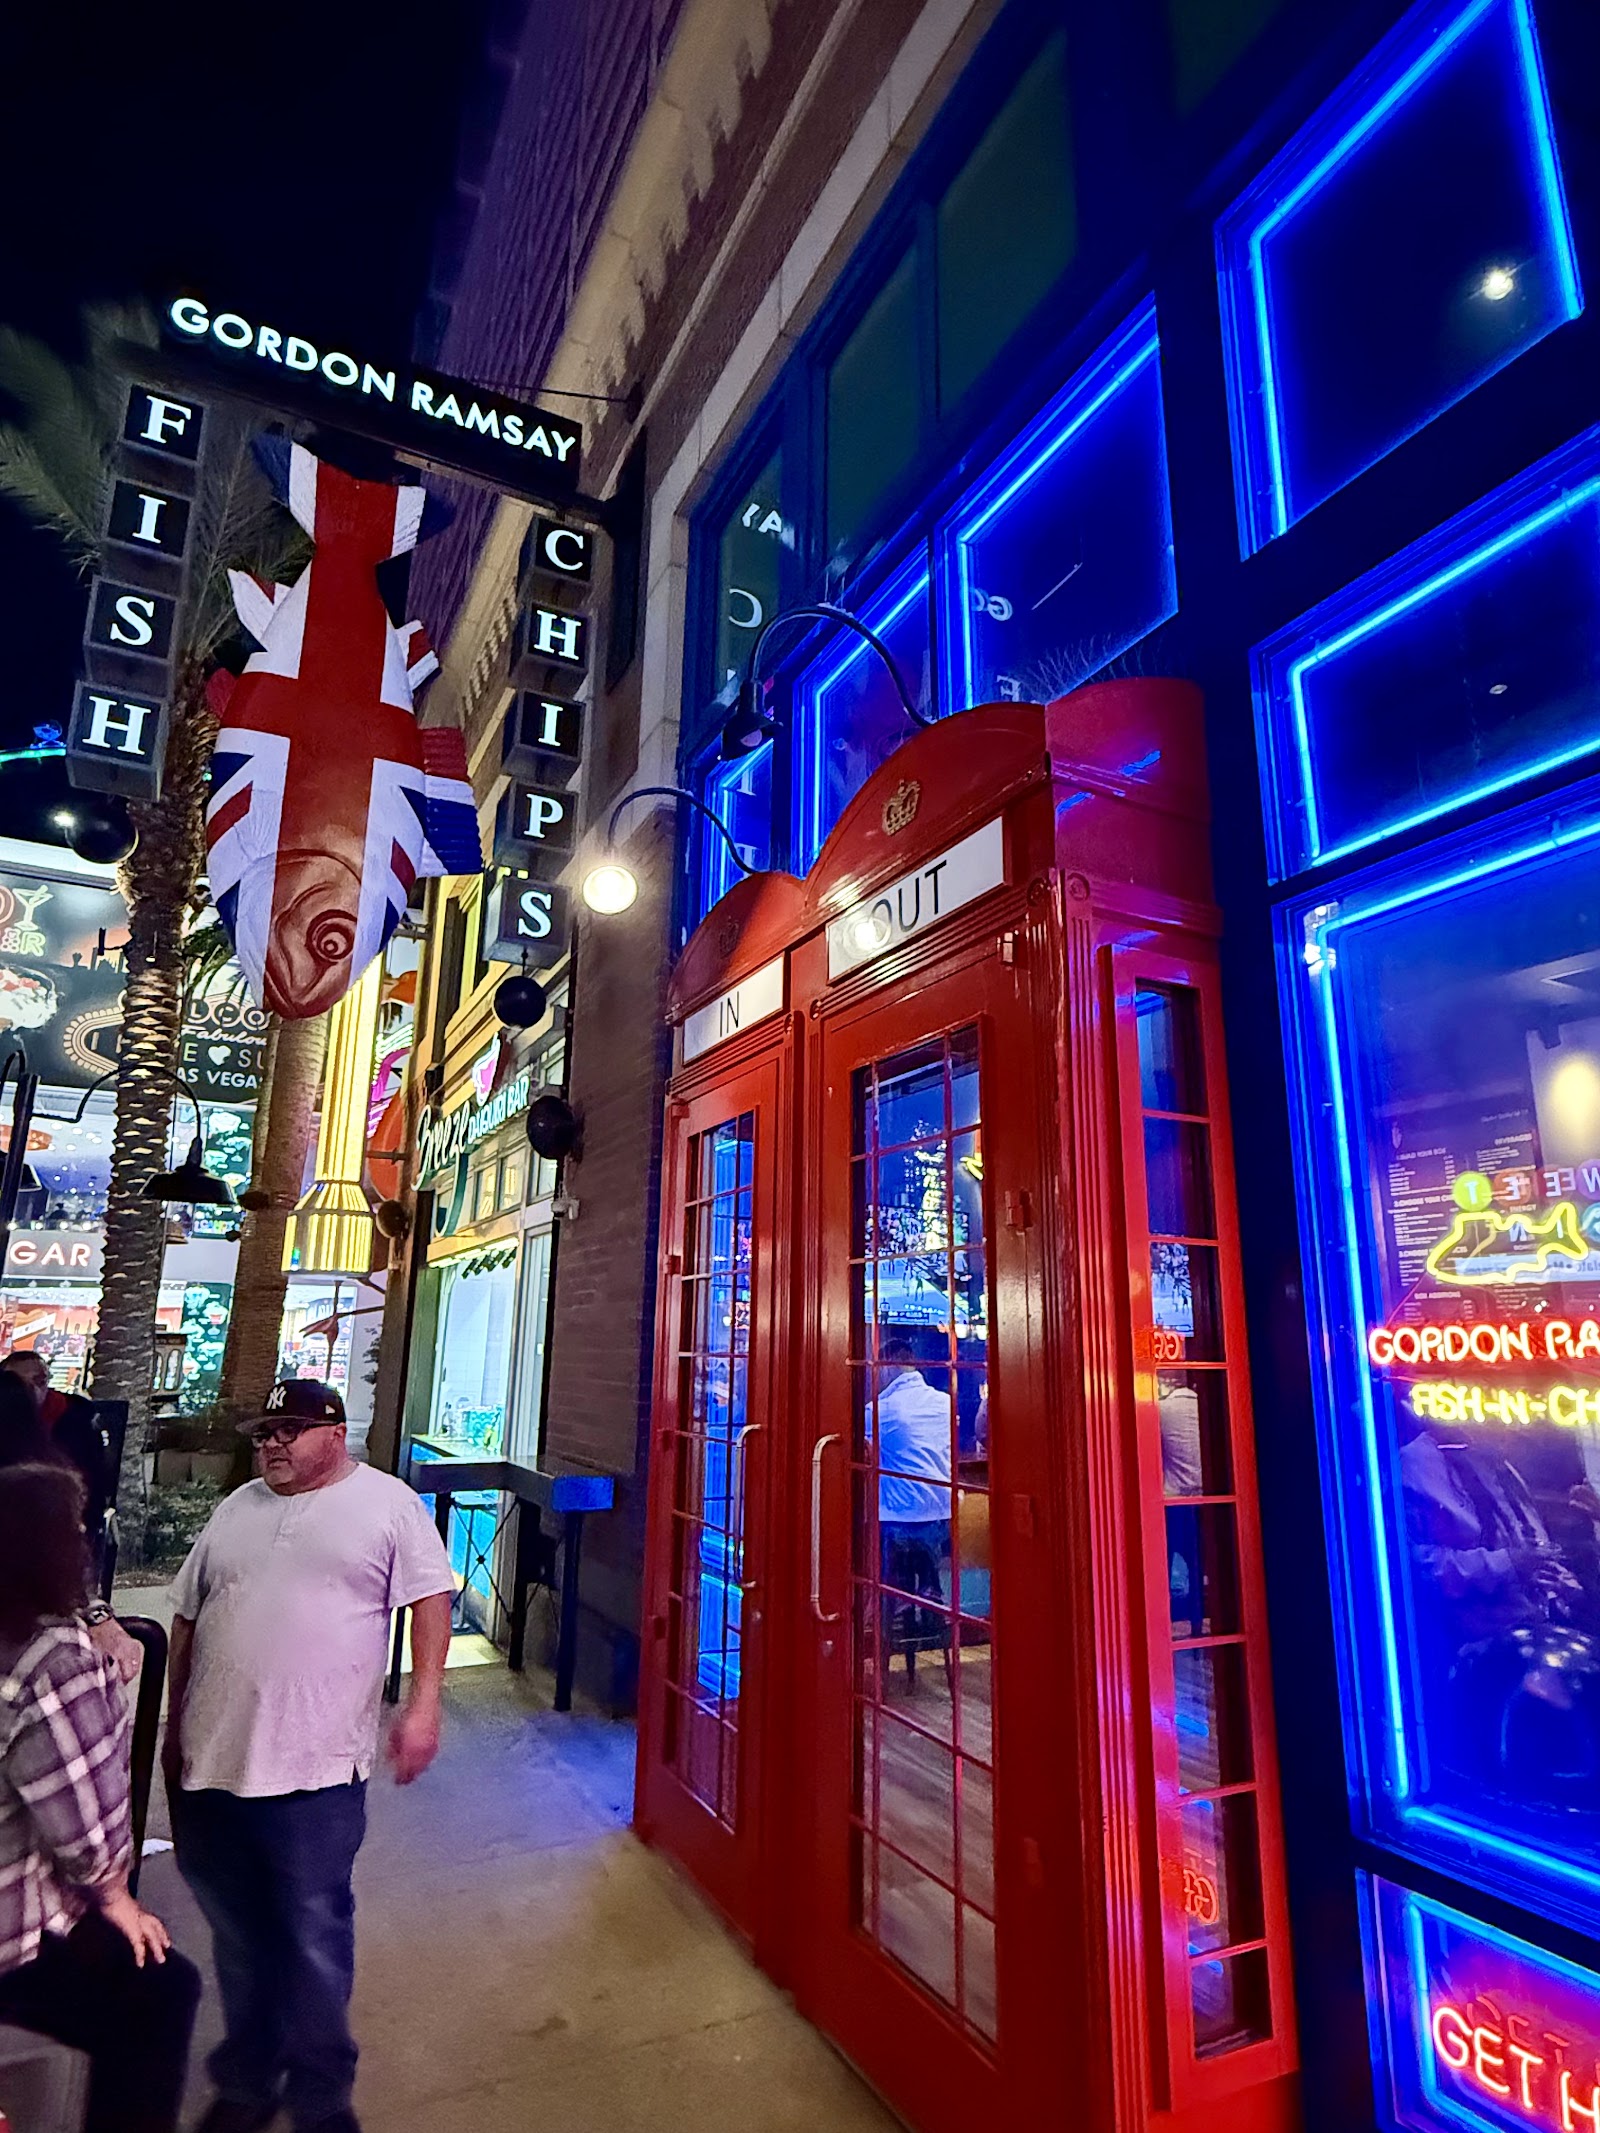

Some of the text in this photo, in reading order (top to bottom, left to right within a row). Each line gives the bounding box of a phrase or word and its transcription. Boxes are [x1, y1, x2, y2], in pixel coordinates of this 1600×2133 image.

[170, 298, 576, 463] GORDON RAMSAY
[82, 395, 192, 756] FISH
[516, 528, 584, 937] CHIPS
[869, 861, 947, 946] OUT
[718, 991, 740, 1038] IN
[507, 1075, 530, 1115] BAR
[1368, 1323, 1533, 1365] GORDON
[266, 1386, 287, 1410] NY
[1433, 2006, 1543, 2109] GET
